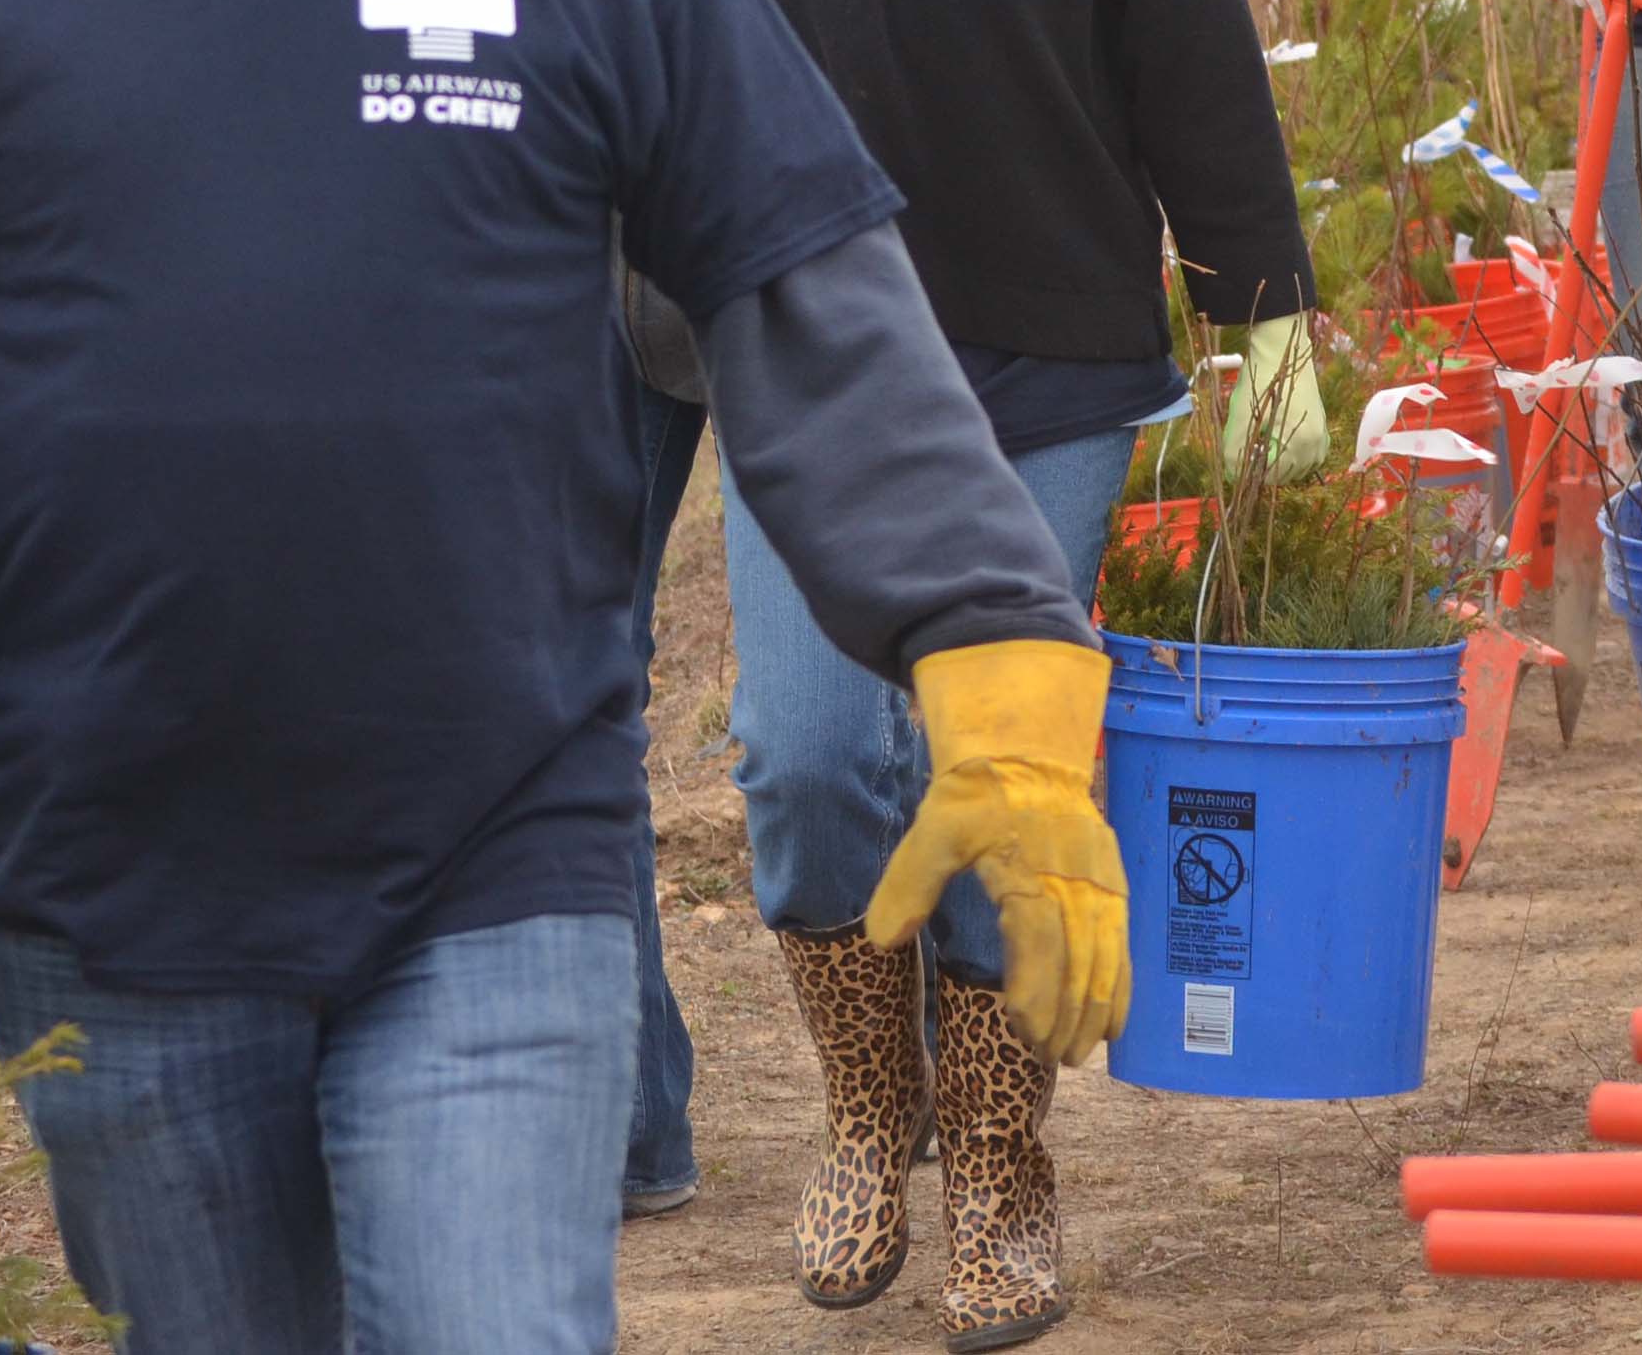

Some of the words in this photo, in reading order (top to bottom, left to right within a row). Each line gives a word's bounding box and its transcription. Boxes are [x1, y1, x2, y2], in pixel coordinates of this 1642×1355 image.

[404, 74, 523, 101] AIRWAYS
[361, 95, 416, 123] DO
[423, 96, 522, 132] CREW
[1183, 790, 1254, 810] WARNING
[1194, 812, 1239, 829] AVISO
